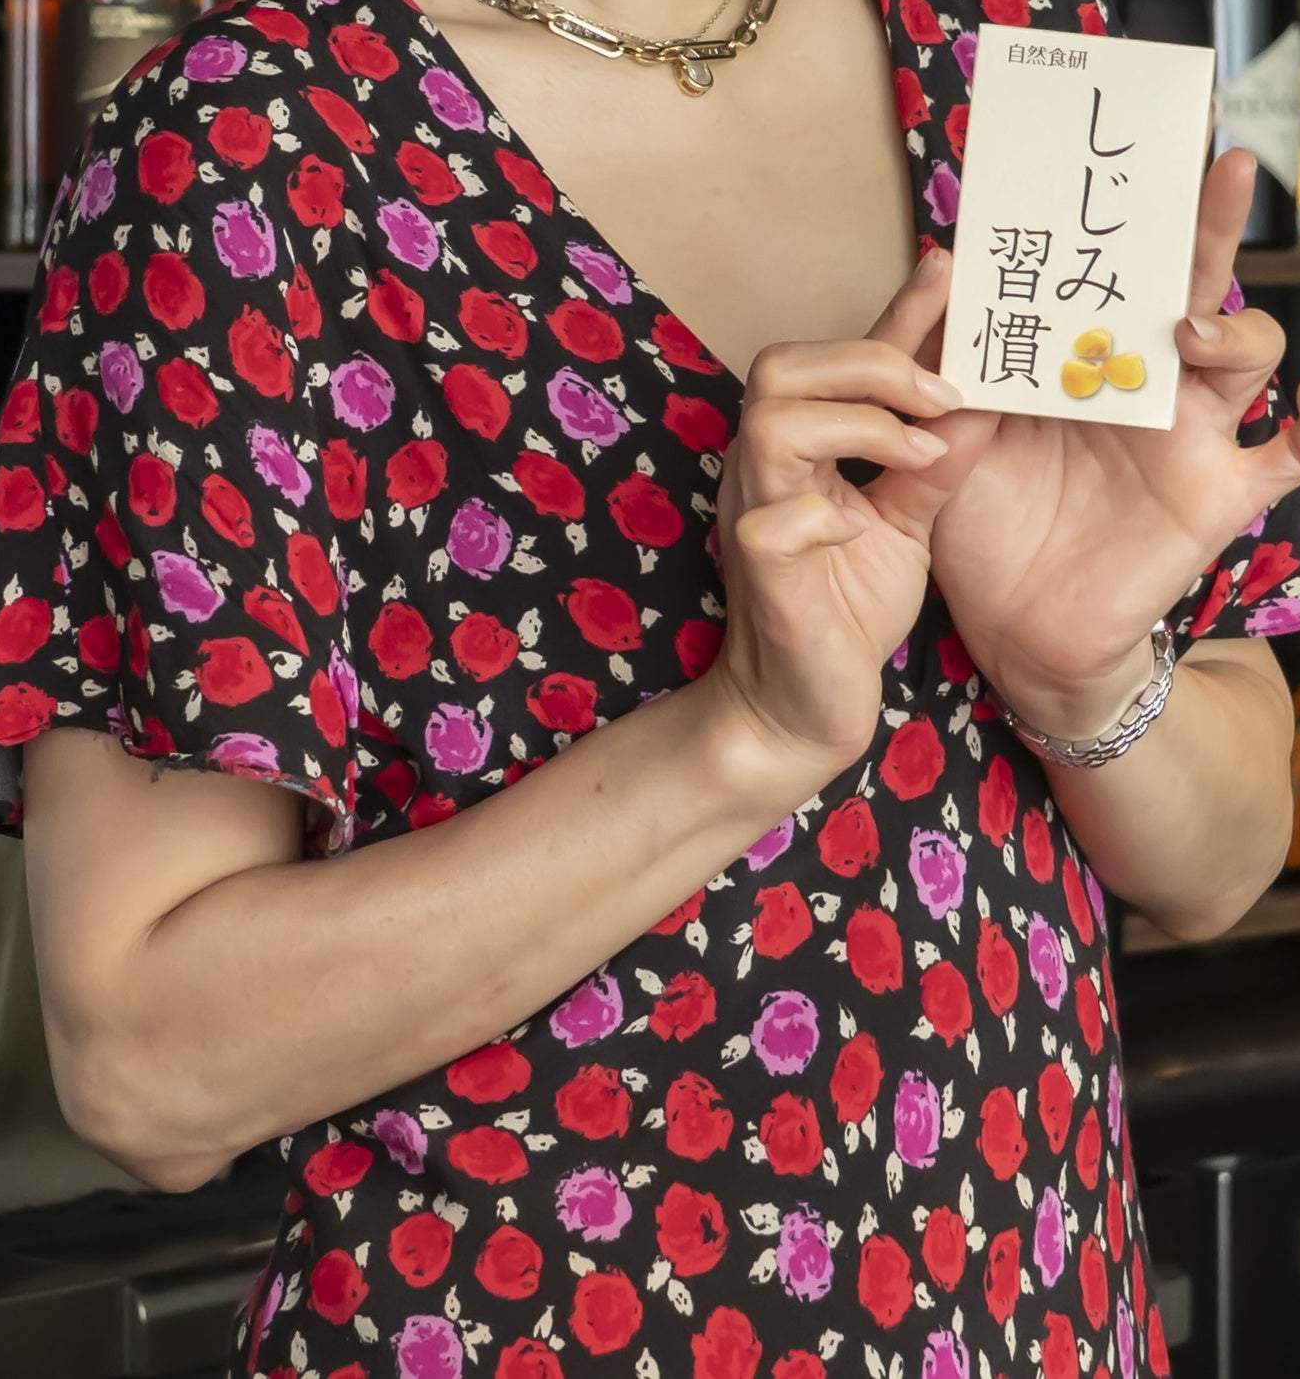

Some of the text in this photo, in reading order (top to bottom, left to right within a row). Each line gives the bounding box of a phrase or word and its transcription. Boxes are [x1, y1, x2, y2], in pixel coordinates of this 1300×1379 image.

[1008, 43, 1088, 70] 自然食研
[1055, 86, 1135, 311] しじみ
[972, 225, 1053, 389] 習慣
